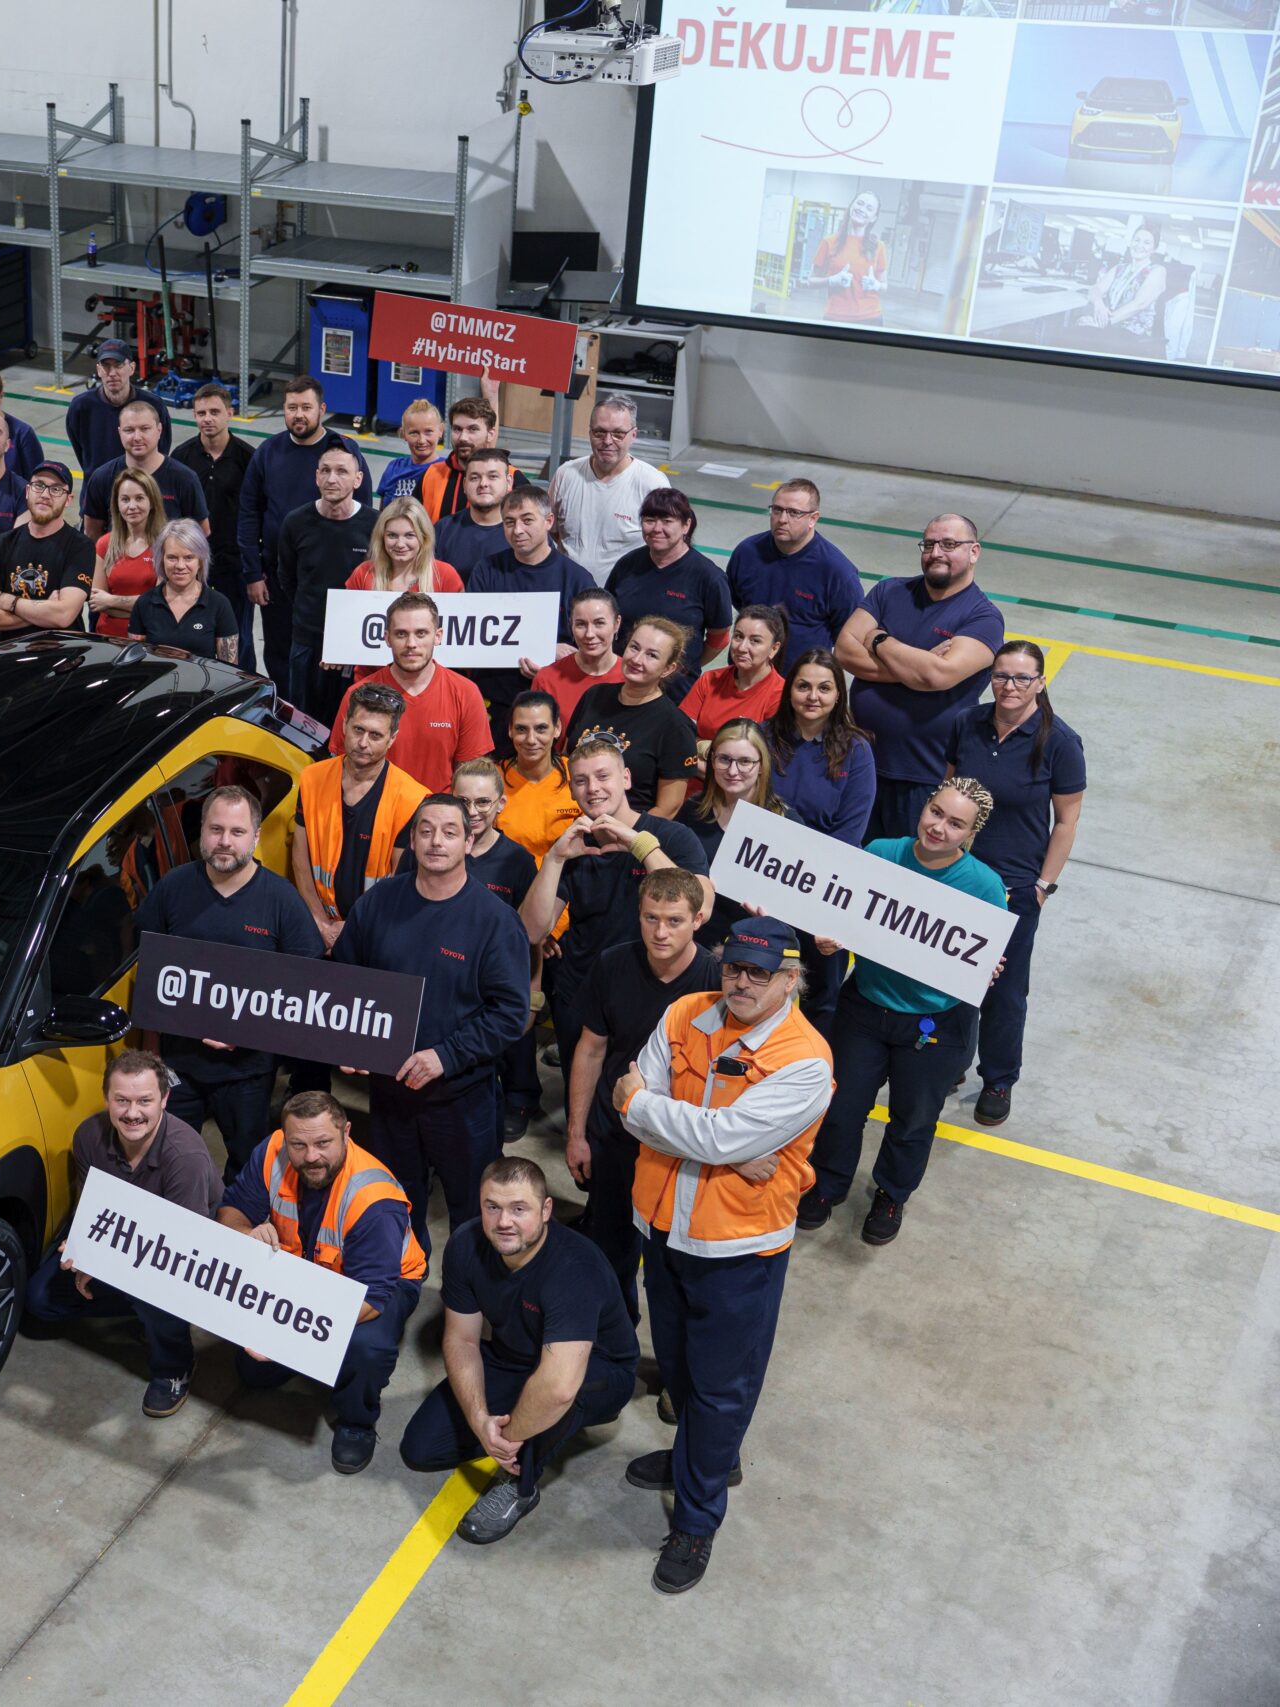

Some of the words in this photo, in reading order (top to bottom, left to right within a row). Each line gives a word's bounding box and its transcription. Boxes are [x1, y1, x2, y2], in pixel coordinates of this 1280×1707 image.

[676, 7, 956, 81] DĚKUJEME
[430, 312, 517, 343] @TMMCZ
[412, 337, 527, 374] #HybridStart
[361, 613, 522, 649] @MCZ
[430, 721, 452, 729] TOYOTA
[487, 883, 511, 894] TOYOTA
[734, 836, 817, 895] Made
[822, 874, 853, 911] in
[863, 888, 989, 968] TMMCZ
[243, 924, 269, 936] TOYOTA
[736, 934, 769, 948] TOYOTA
[440, 947, 465, 961] TOYOTA
[156, 965, 394, 1040] @ToyotaKolín
[87, 1207, 334, 1343] #HybridHeroes
